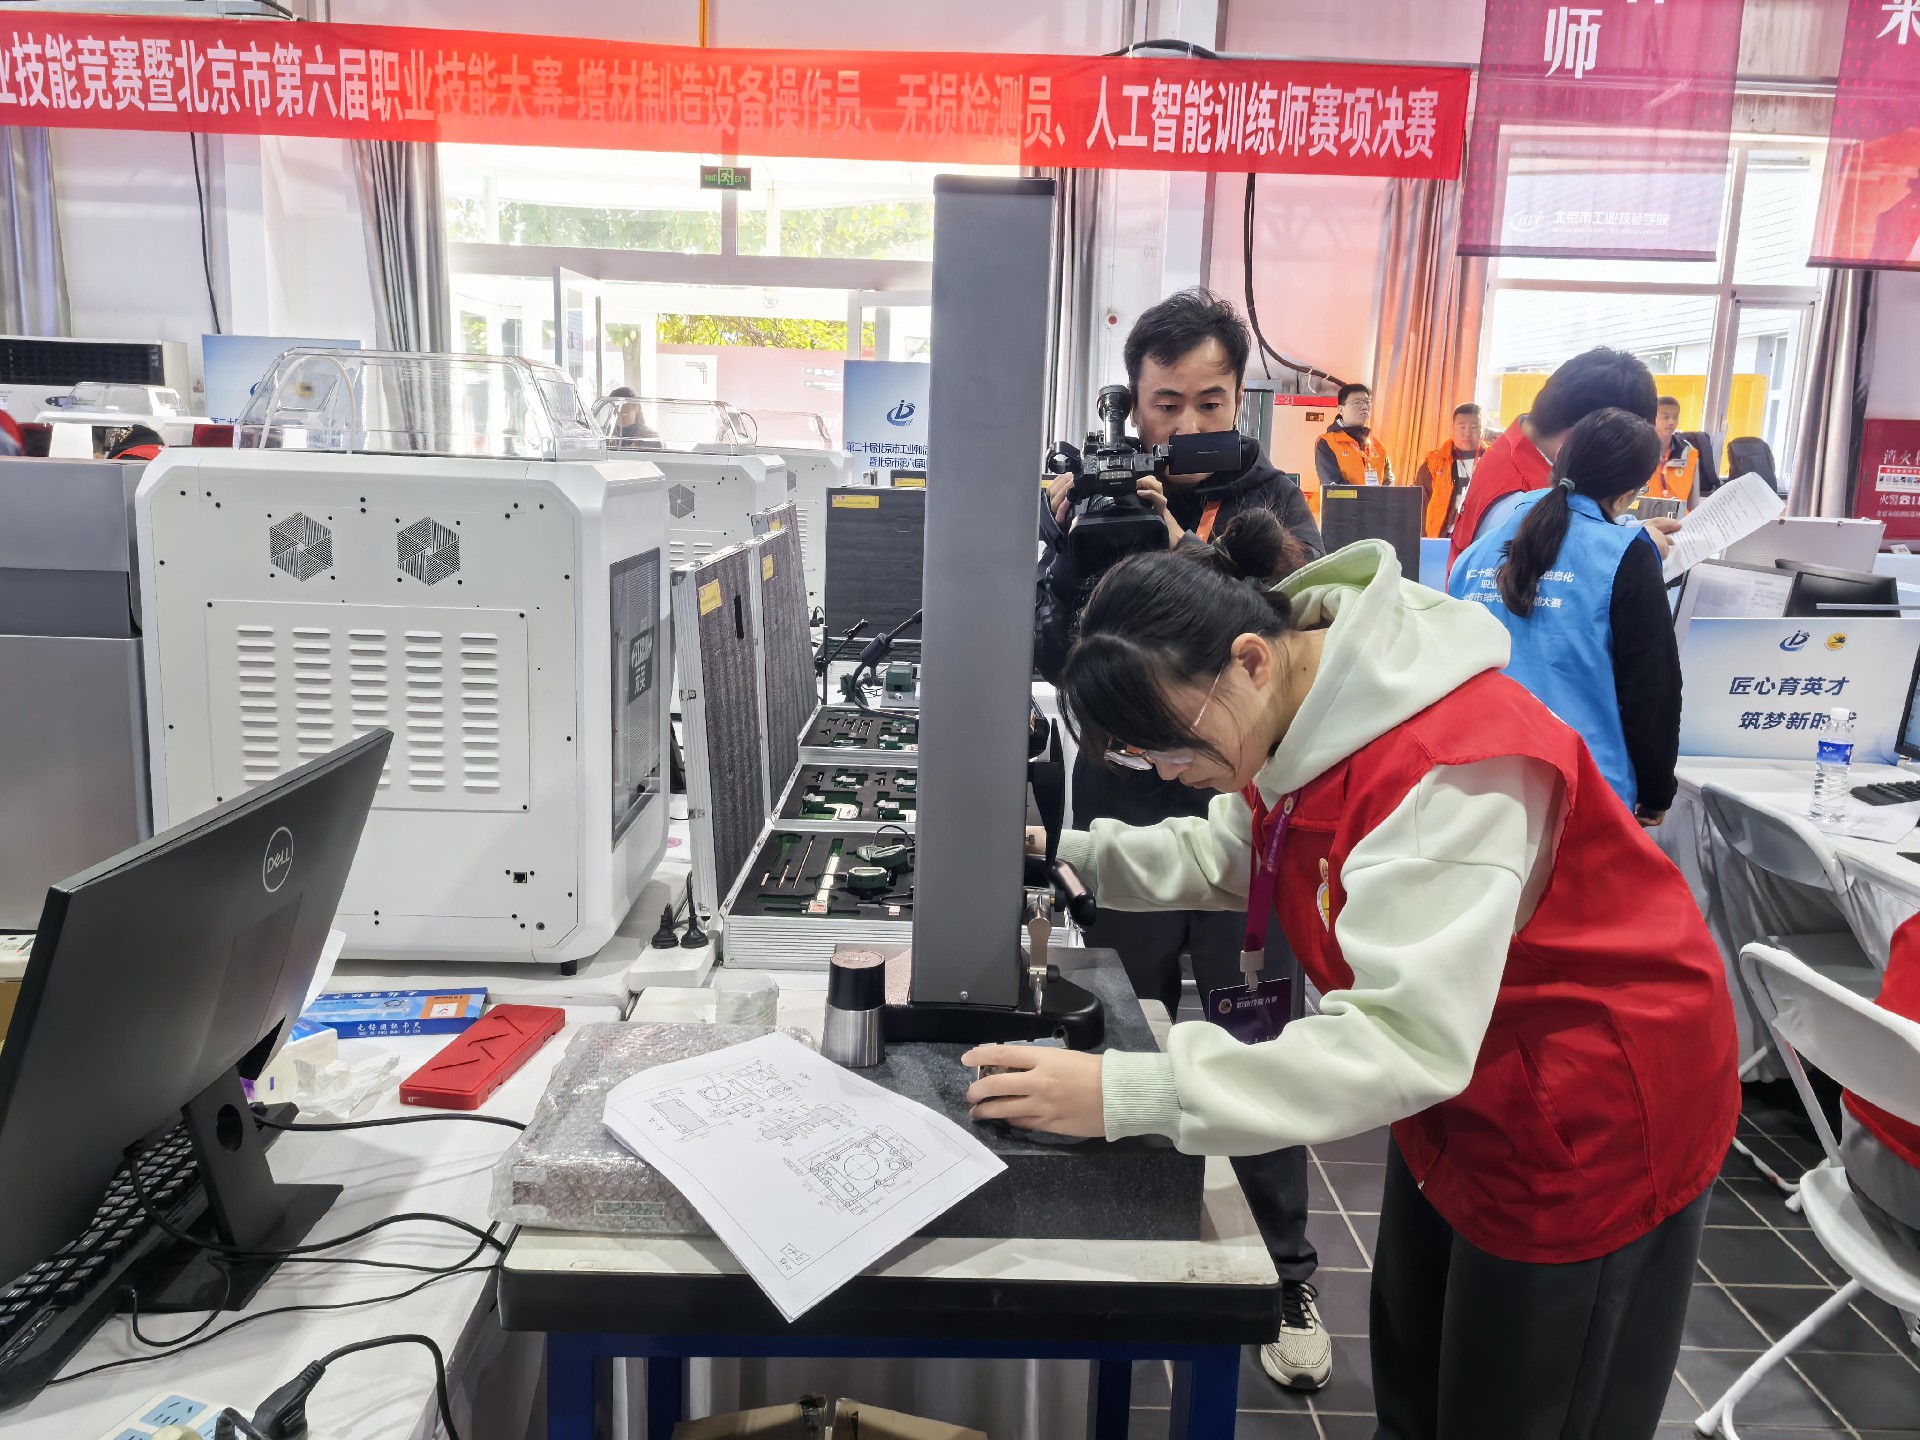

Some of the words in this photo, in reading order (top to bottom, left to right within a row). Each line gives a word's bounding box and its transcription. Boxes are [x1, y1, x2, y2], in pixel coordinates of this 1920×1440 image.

[1544, 7, 1602, 79] 师
[1728, 676, 1849, 696] 匠心育英才
[266, 846, 290, 874] DELL
